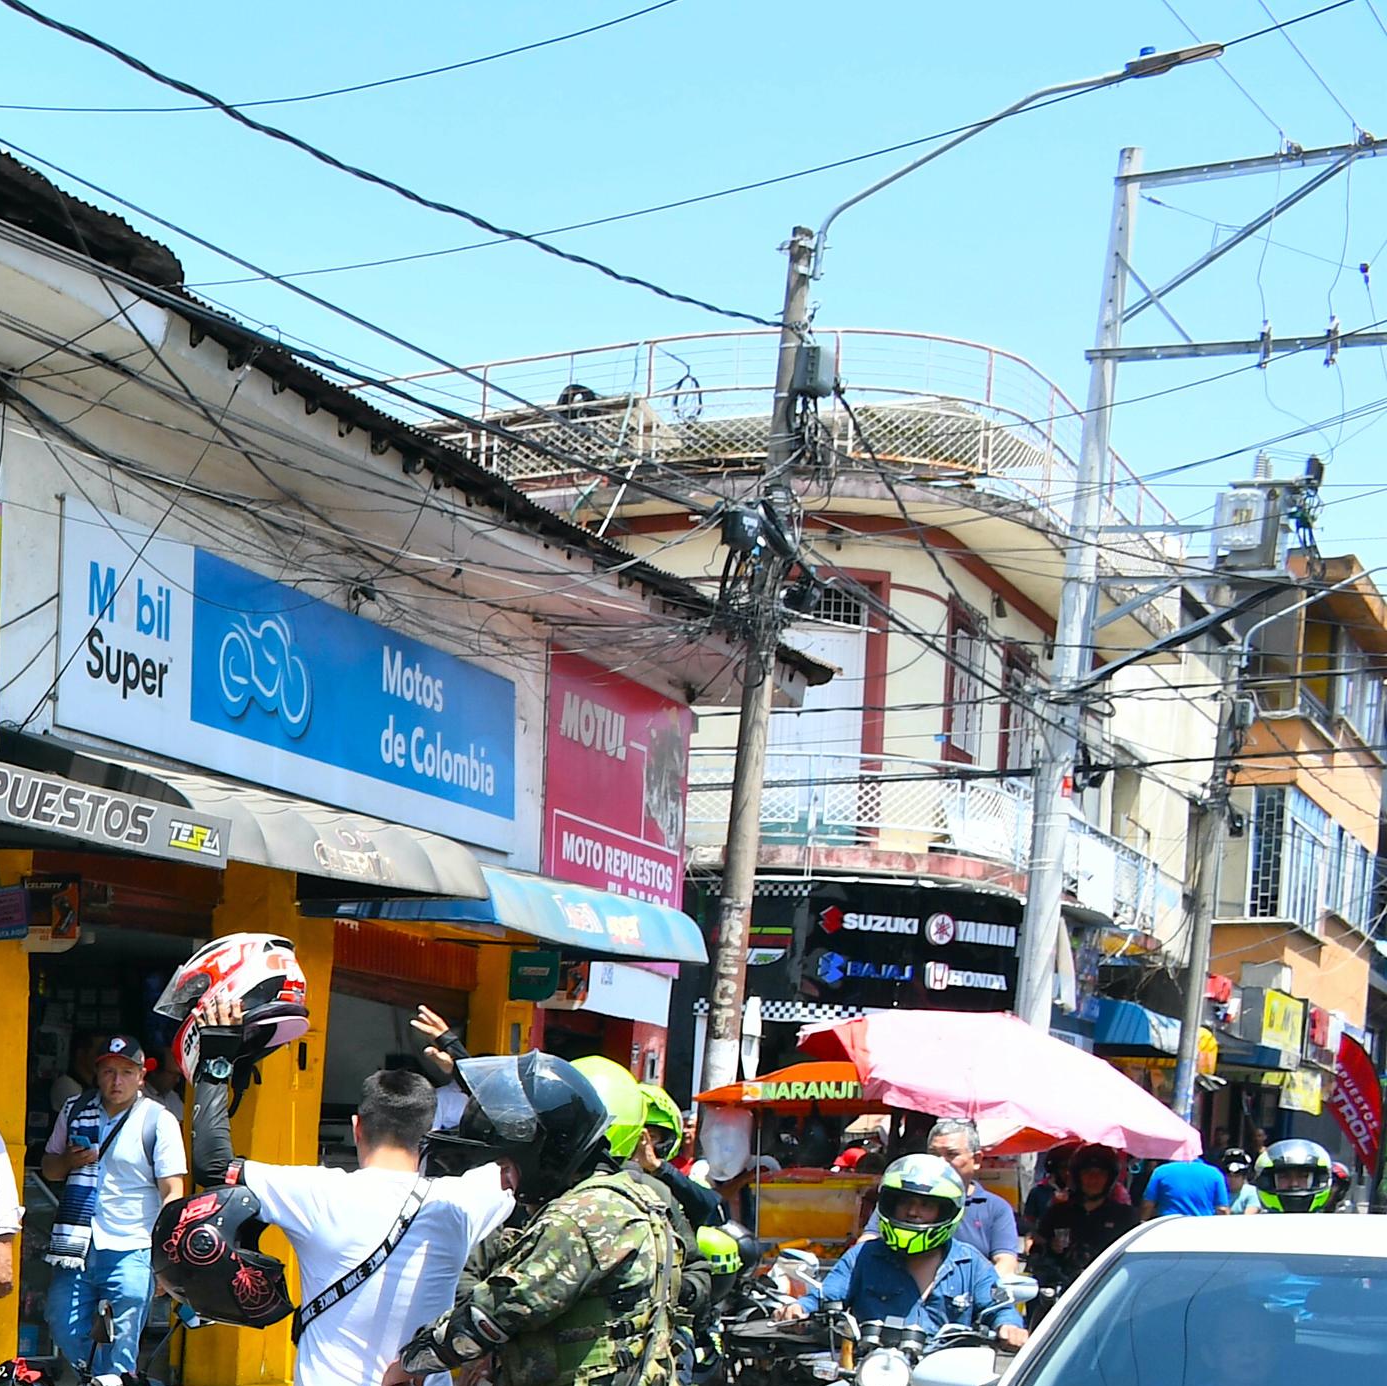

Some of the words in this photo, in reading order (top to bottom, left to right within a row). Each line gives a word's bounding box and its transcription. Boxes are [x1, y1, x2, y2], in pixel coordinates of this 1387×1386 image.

[88, 561, 170, 642] Mbil
[85, 630, 169, 700] Super
[382, 646, 444, 712] Motos
[381, 714, 405, 769] de
[410, 726, 494, 798] Colombia
[560, 691, 626, 761] MOTUL
[562, 831, 603, 870] MOTO
[605, 846, 673, 893] REPUESTOS
[843, 913, 920, 935] SUZUKI
[955, 920, 1016, 948] YAMAHA
[846, 960, 914, 982] BAJAJ
[948, 970, 1007, 991] HONDA
[1331, 1086, 1372, 1155] TROL
[1335, 1062, 1379, 1130] EPUESTOS
[342, 1268, 365, 1292] NIKE
